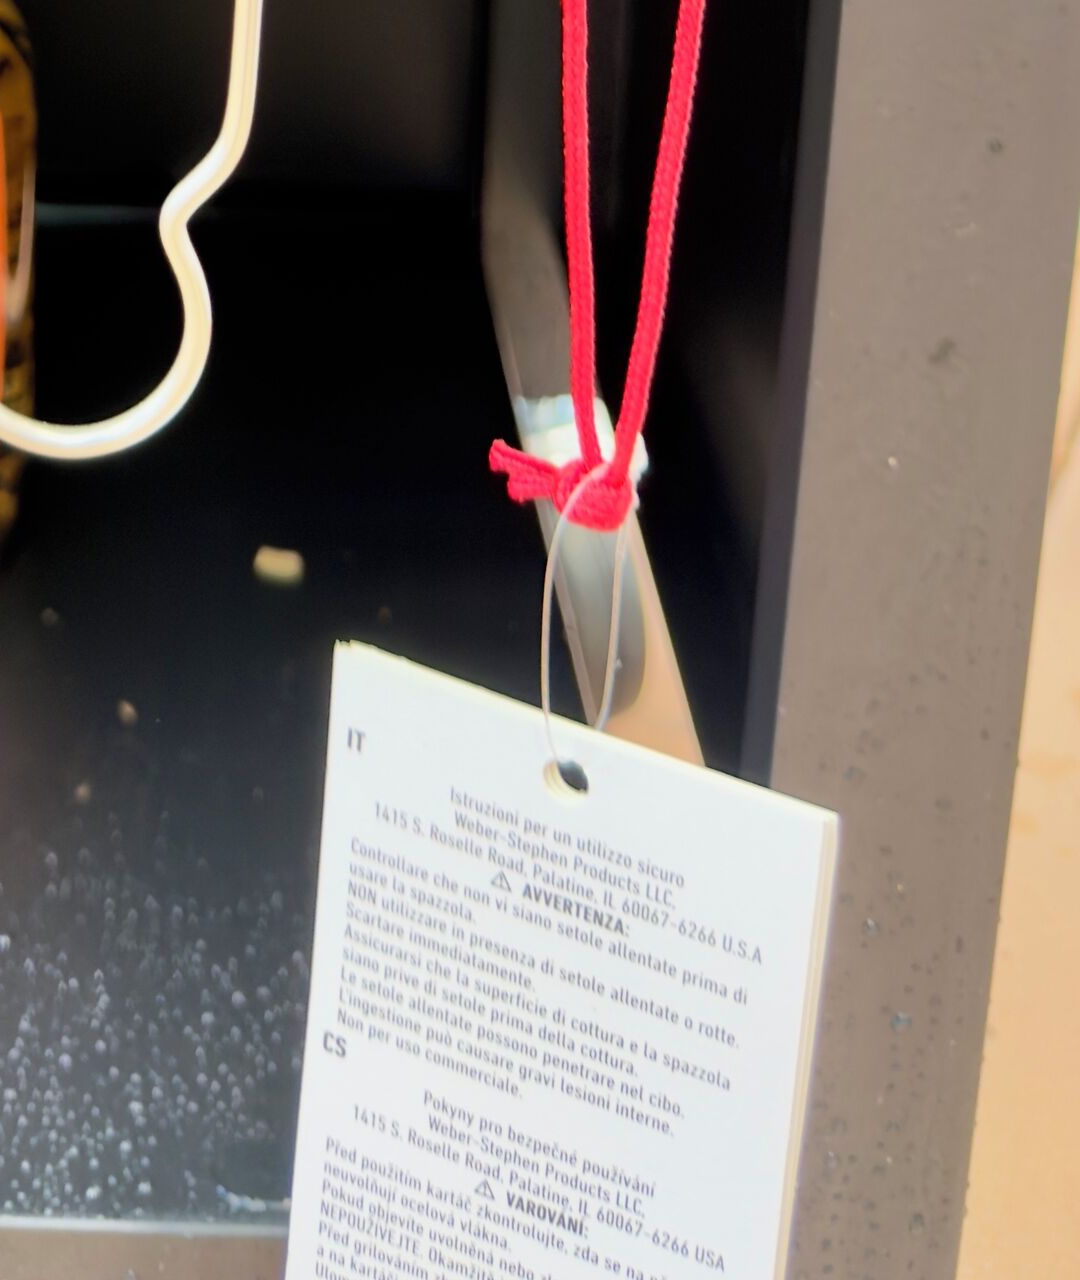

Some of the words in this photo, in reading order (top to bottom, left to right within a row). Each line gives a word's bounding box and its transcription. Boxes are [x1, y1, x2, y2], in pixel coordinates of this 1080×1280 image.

[346, 726, 366, 753] IT
[450, 787, 518, 826] Istruzioni
[522, 818, 546, 837] per
[552, 829, 571, 846] un
[576, 837, 632, 869] utilizzo
[637, 860, 684, 888] sicuro
[454, 810, 567, 867] Weber-Stephen
[572, 855, 640, 895] Products
[348, 863, 387, 888] usare
[391, 875, 405, 895] la
[410, 887, 474, 922] spazzola.
[350, 838, 428, 881] Controllare
[432, 872, 458, 893] che
[463, 885, 490, 906] non
[494, 897, 507, 912] vi
[512, 905, 552, 930] siano
[556, 922, 603, 949] setole
[607, 940, 677, 977] allentate
[681, 969, 727, 998] prima
[732, 986, 747, 1005] di
[375, 801, 407, 828] 1415
[429, 823, 482, 858] Roselle
[602, 889, 614, 909] IL
[621, 898, 716, 946] 60067-6266
[721, 934, 762, 964] U.S.A
[521, 882, 629, 937] AVVERTENZA:
[345, 901, 404, 938] Scartare
[408, 931, 534, 990] immediatamente.
[347, 879, 377, 905] NON
[381, 897, 447, 933] utilizzare
[451, 924, 465, 941] in
[469, 932, 535, 969] presenza
[540, 958, 554, 976] di
[559, 968, 605, 996] setole
[609, 987, 679, 1024] allentate
[683, 1016, 693, 1030] o
[697, 1021, 737, 1047] rotte.
[322, 1030, 347, 1058] CS
[336, 1007, 364, 1032] Non
[367, 1024, 389, 1043] per
[395, 1036, 420, 1056] uso
[424, 1049, 521, 1096] commerciale.
[340, 964, 356, 985] Le
[361, 978, 403, 1004] setole
[408, 996, 472, 1032] allentate
[476, 1024, 538, 1059] possono
[541, 1051, 615, 1090] penetrare
[619, 1081, 643, 1102] nel
[648, 1093, 683, 1117] cibo.
[342, 948, 379, 973] siano
[383, 964, 419, 989] prive
[423, 978, 437, 996] di
[441, 988, 486, 1016] setole
[489, 1007, 533, 1035] prima
[537, 1024, 575, 1052] della
[579, 1043, 637, 1077] cottura.
[343, 923, 421, 968] Assicurarsi
[425, 958, 451, 979] che
[455, 967, 469, 988] la
[474, 979, 547, 1018] superficie
[551, 1007, 566, 1026] di
[570, 1018, 624, 1049] cottura
[628, 1040, 638, 1054] e
[642, 1041, 658, 1062] la
[662, 1053, 730, 1091] spazzola
[425, 1026, 452, 1047] può
[456, 1039, 514, 1072] causare
[518, 1064, 555, 1089] gravi
[560, 1076, 610, 1110] lesioni
[614, 1098, 672, 1135] interne.
[423, 1089, 474, 1127] Pokyny
[478, 1116, 502, 1136] pro
[507, 1124, 577, 1167] bezpečné
[428, 1114, 539, 1173] Weber-Stephen
[544, 1161, 610, 1203] Products
[321, 1178, 364, 1211] Pokud
[428, 1228, 494, 1266] uvolněná
[325, 1136, 357, 1164] Před
[360, 1156, 421, 1191] použitím
[425, 1179, 471, 1212] kartáč
[572, 1245, 599, 1266] zda
[603, 1256, 621, 1275] se
[625, 1265, 644, 1280] na
[353, 1104, 386, 1132] 1415
[407, 1127, 460, 1163] Roselle
[577, 1197, 590, 1218] IL
[596, 1206, 689, 1257] 60067-6266
[694, 1244, 725, 1272] USA
[399, 1195, 455, 1228] ocelová
[459, 1218, 512, 1252] vlákna.
[506, 1190, 588, 1239] VAROVÁNÍ:
[316, 1245, 324, 1258] a
[328, 1249, 345, 1267] na
[317, 1219, 349, 1247] Před
